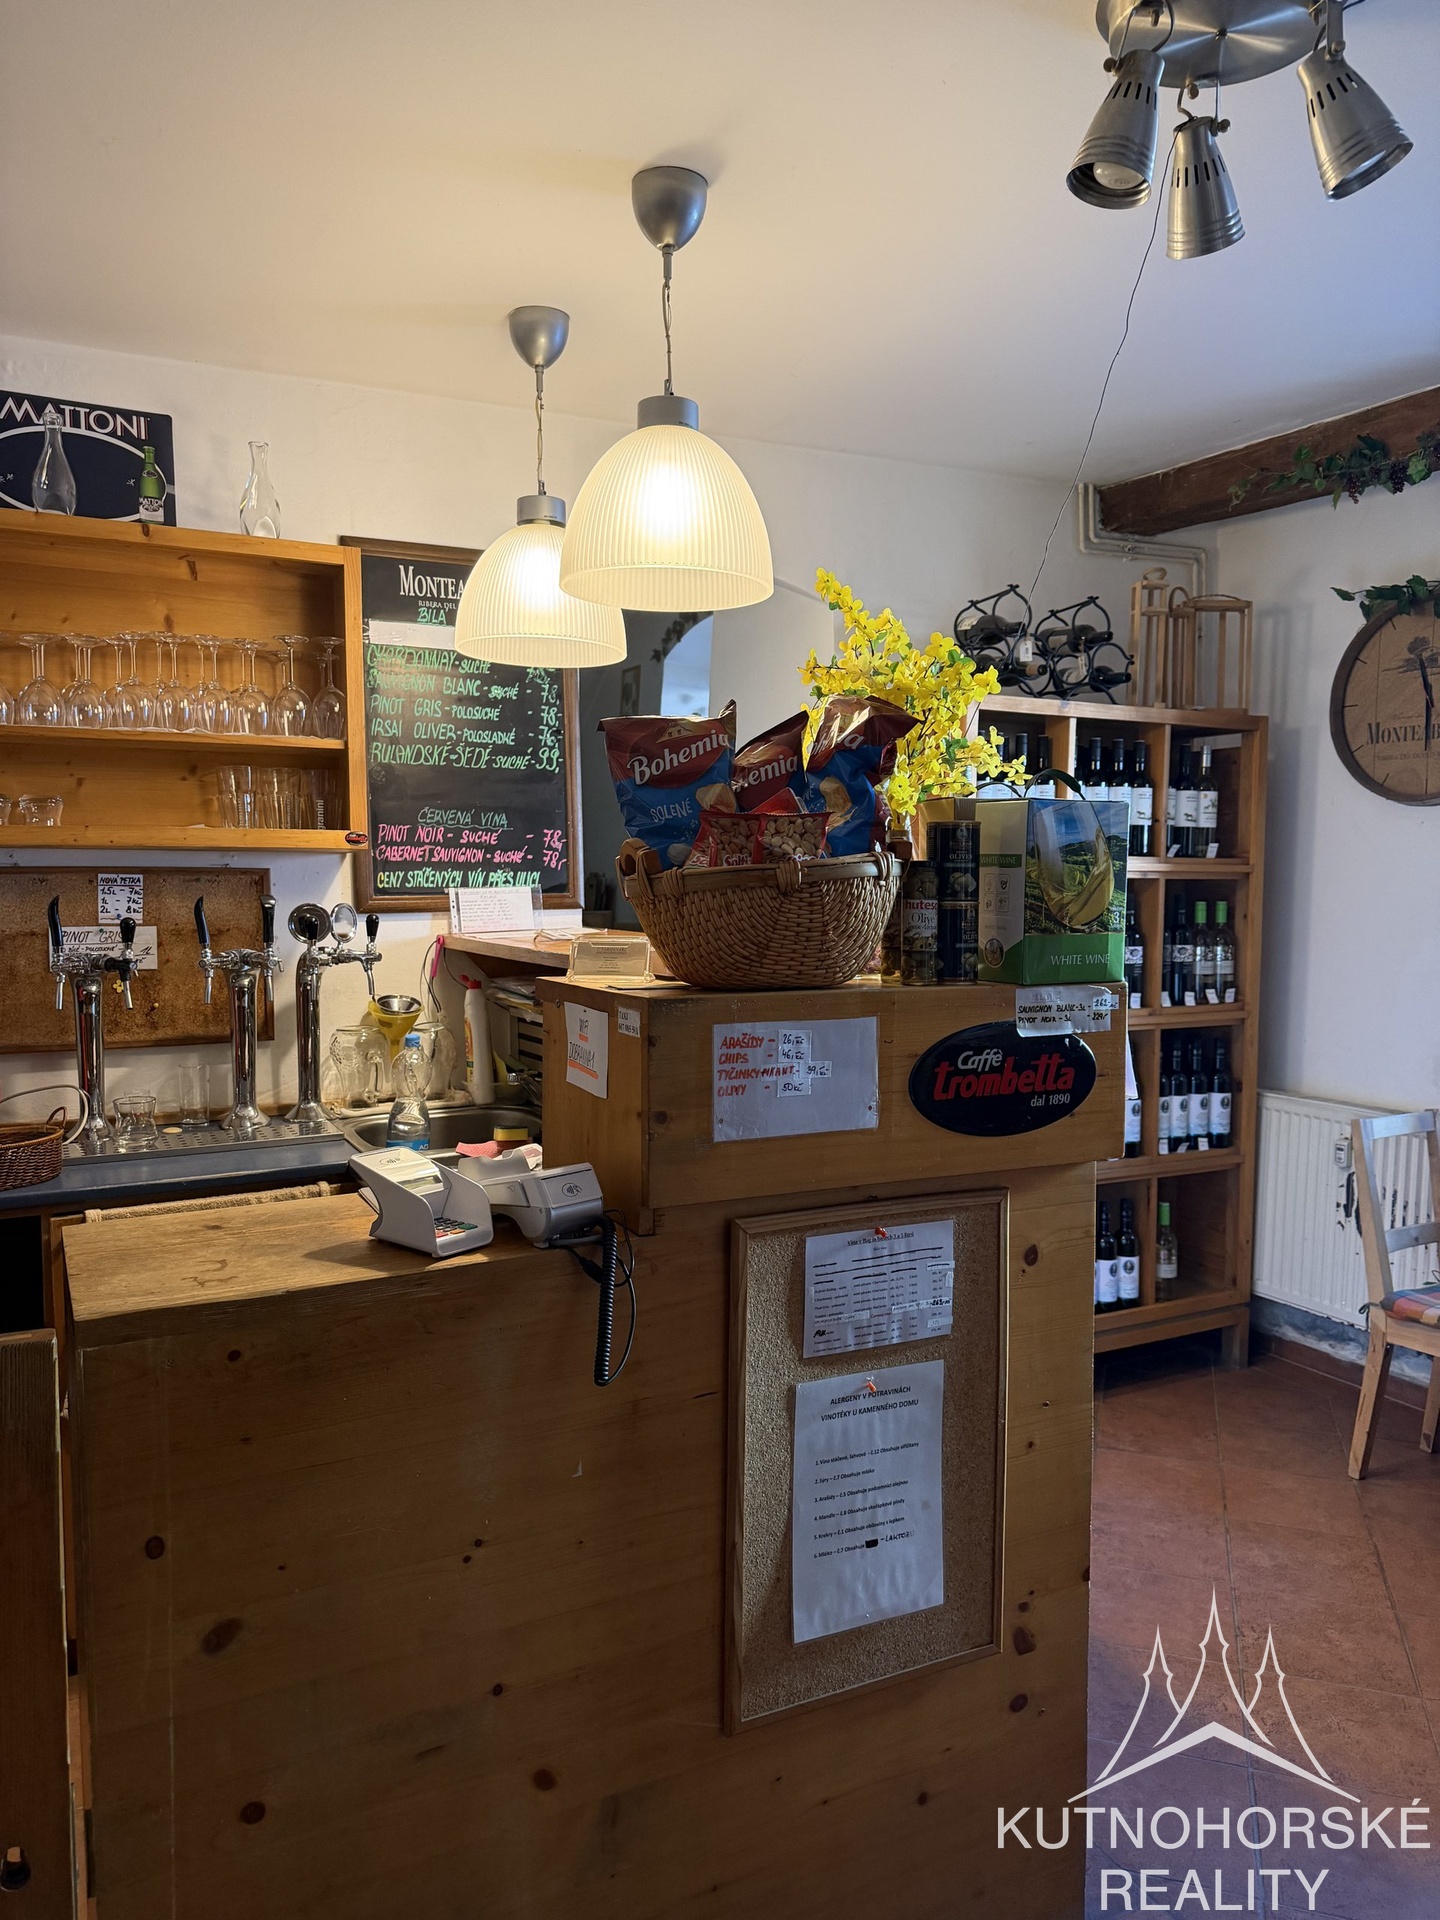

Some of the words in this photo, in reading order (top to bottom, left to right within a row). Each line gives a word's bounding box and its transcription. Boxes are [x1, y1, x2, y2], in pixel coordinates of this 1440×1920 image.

[0, 397, 147, 440] MATTONI
[443, 676, 481, 696] BLANC
[370, 694, 406, 715] PINOT
[414, 697, 443, 718] GRIS
[370, 718, 402, 738] IRSAI
[414, 722, 456, 741] OLIVER
[626, 729, 729, 786] Bohemia
[650, 797, 693, 823] SOLENÉ
[378, 823, 412, 844] PINOT
[414, 825, 445, 844] NOIR
[376, 844, 435, 863] CABERNET
[431, 846, 485, 863] SAUVIGNON
[377, 870, 405, 889] CENY
[405, 866, 463, 888] STÁČENÝCH
[468, 867, 486, 888] VÍN
[62, 930, 93, 943] PINOT
[1051, 954, 1082, 966] WHITE
[1085, 953, 1110, 964] WINE
[720, 1032, 764, 1050] ARAŠÍDY
[718, 1053, 749, 1065] CHIPS
[957, 1048, 1003, 1072] Caffè
[717, 1065, 760, 1081] TYČINKY
[933, 1053, 1075, 1101] trombetta
[1030, 1094, 1045, 1107] dal
[1048, 1093, 1070, 1106] 1890
[830, 1393, 861, 1405] ALERGENY
[868, 1385, 911, 1399] POTRAVINÁCH
[820, 1410, 852, 1422] VINOTÉKY
[858, 1402, 898, 1415] KAMENNÉHO
[899, 1398, 919, 1408] DOMU
